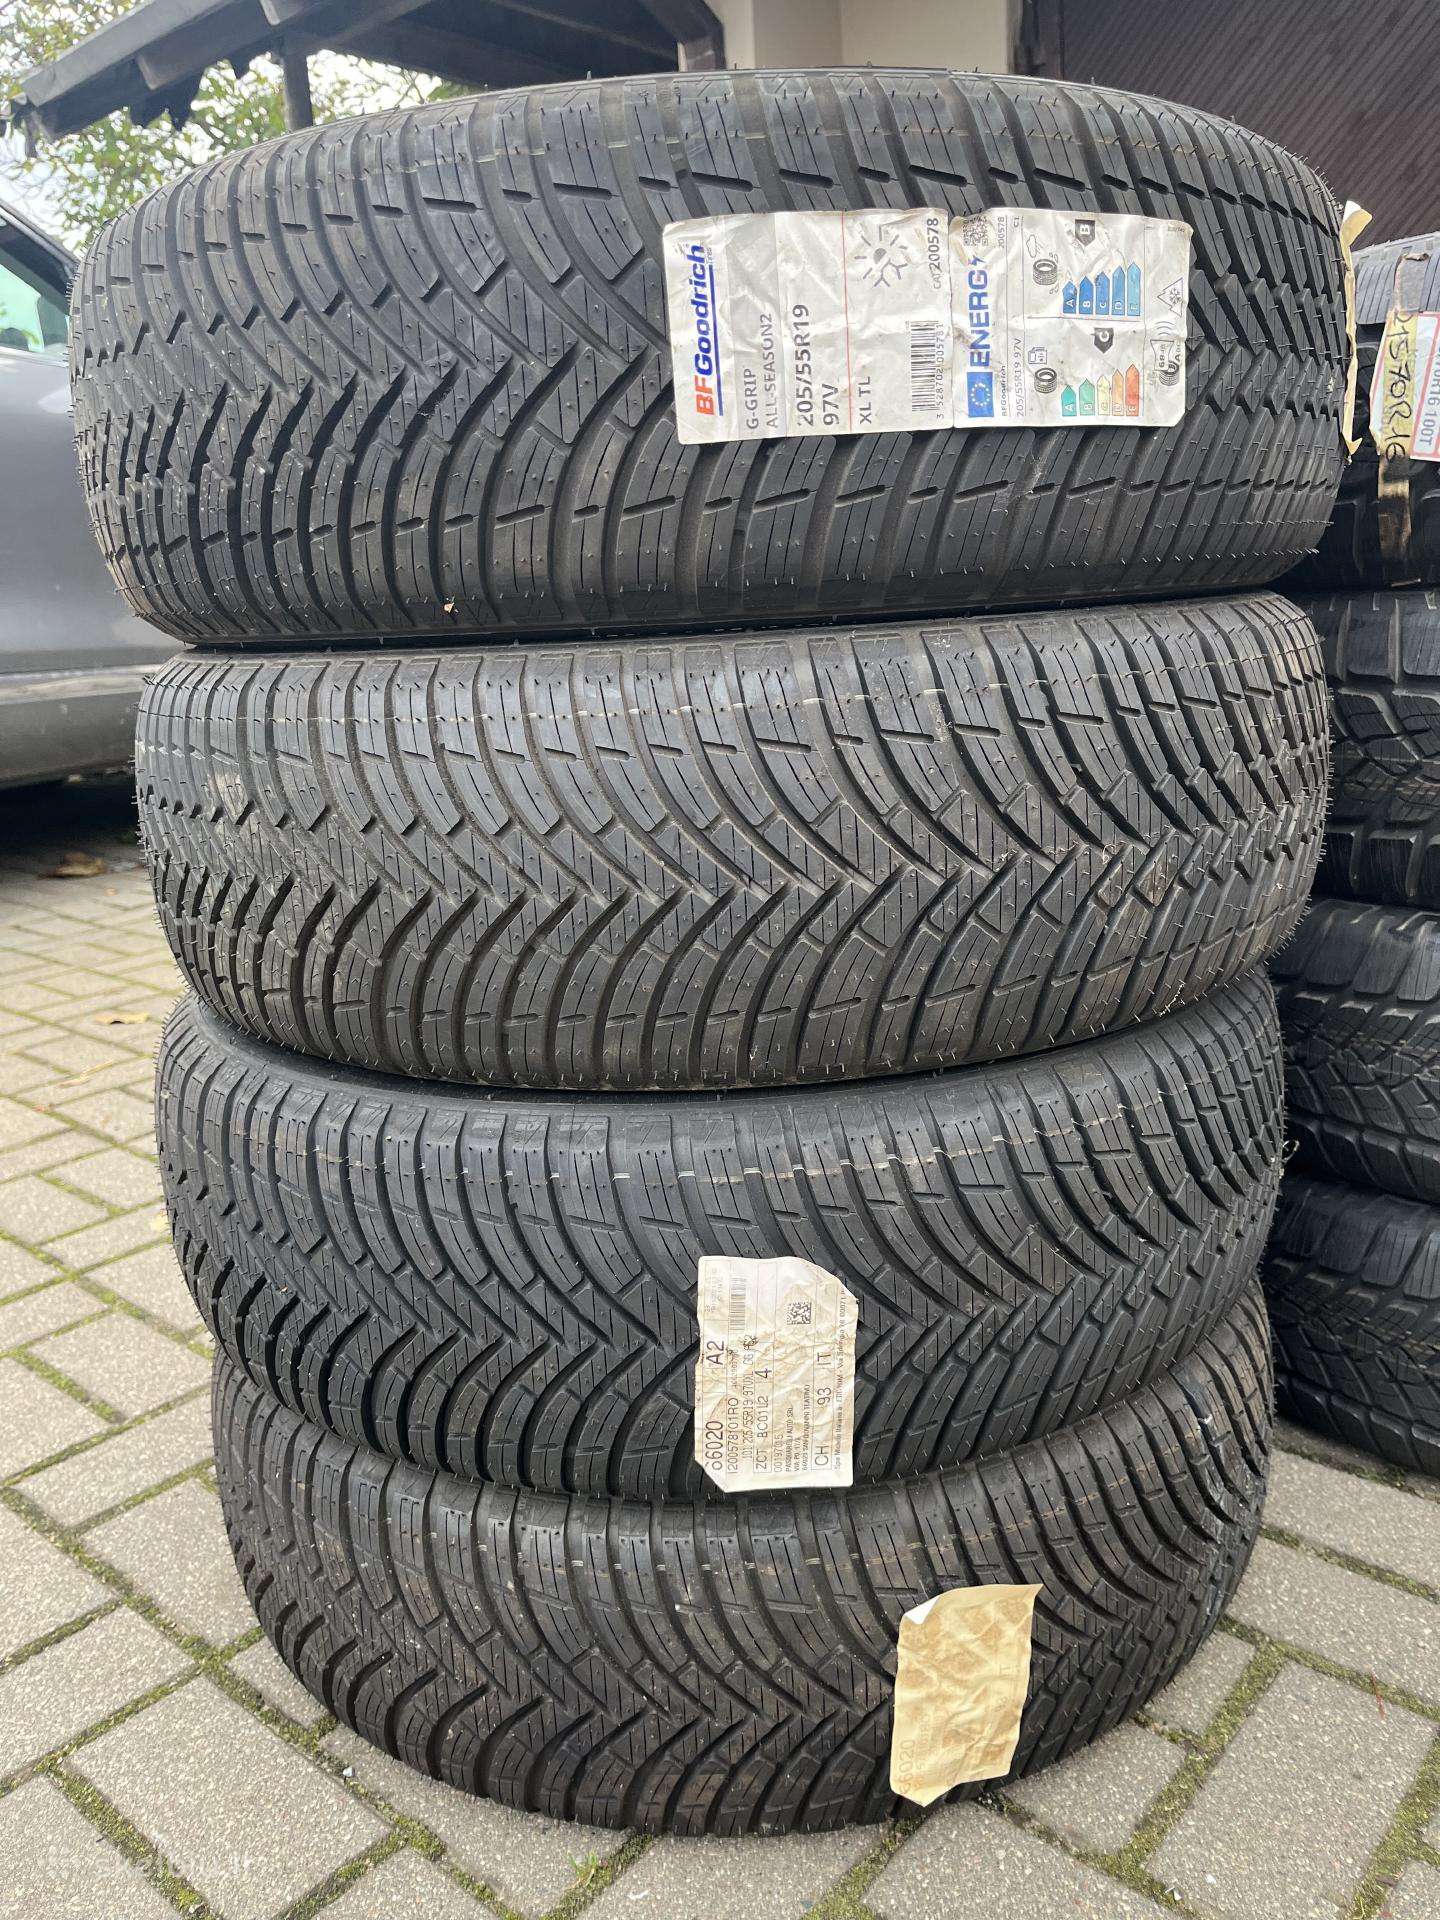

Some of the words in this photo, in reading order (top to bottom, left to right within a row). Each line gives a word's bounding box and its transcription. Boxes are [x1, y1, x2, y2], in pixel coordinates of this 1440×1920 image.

[1079, 224, 1091, 235] B
[686, 243, 716, 416] BFGoodrich
[967, 269, 992, 368] ENERG
[1012, 337, 1022, 358] 97V
[1099, 330, 1110, 342] C
[760, 313, 778, 429] ALL-SEASON2
[792, 304, 814, 427] 205/55R19
[746, 368, 760, 430] G-GRIP
[858, 376, 872, 398] TL
[1014, 362, 1024, 417] 205/55R19
[822, 383, 840, 426] 97V
[859, 401, 872, 425] XL
[1419, 411, 1438, 446] 100T
[705, 1339, 725, 1365] A2
[817, 1351, 831, 1366] IT
[755, 1368, 772, 1380] 4
[817, 1387, 832, 1406] 93
[755, 1448, 768, 1470] ZCT
[814, 1445, 829, 1467] CH
